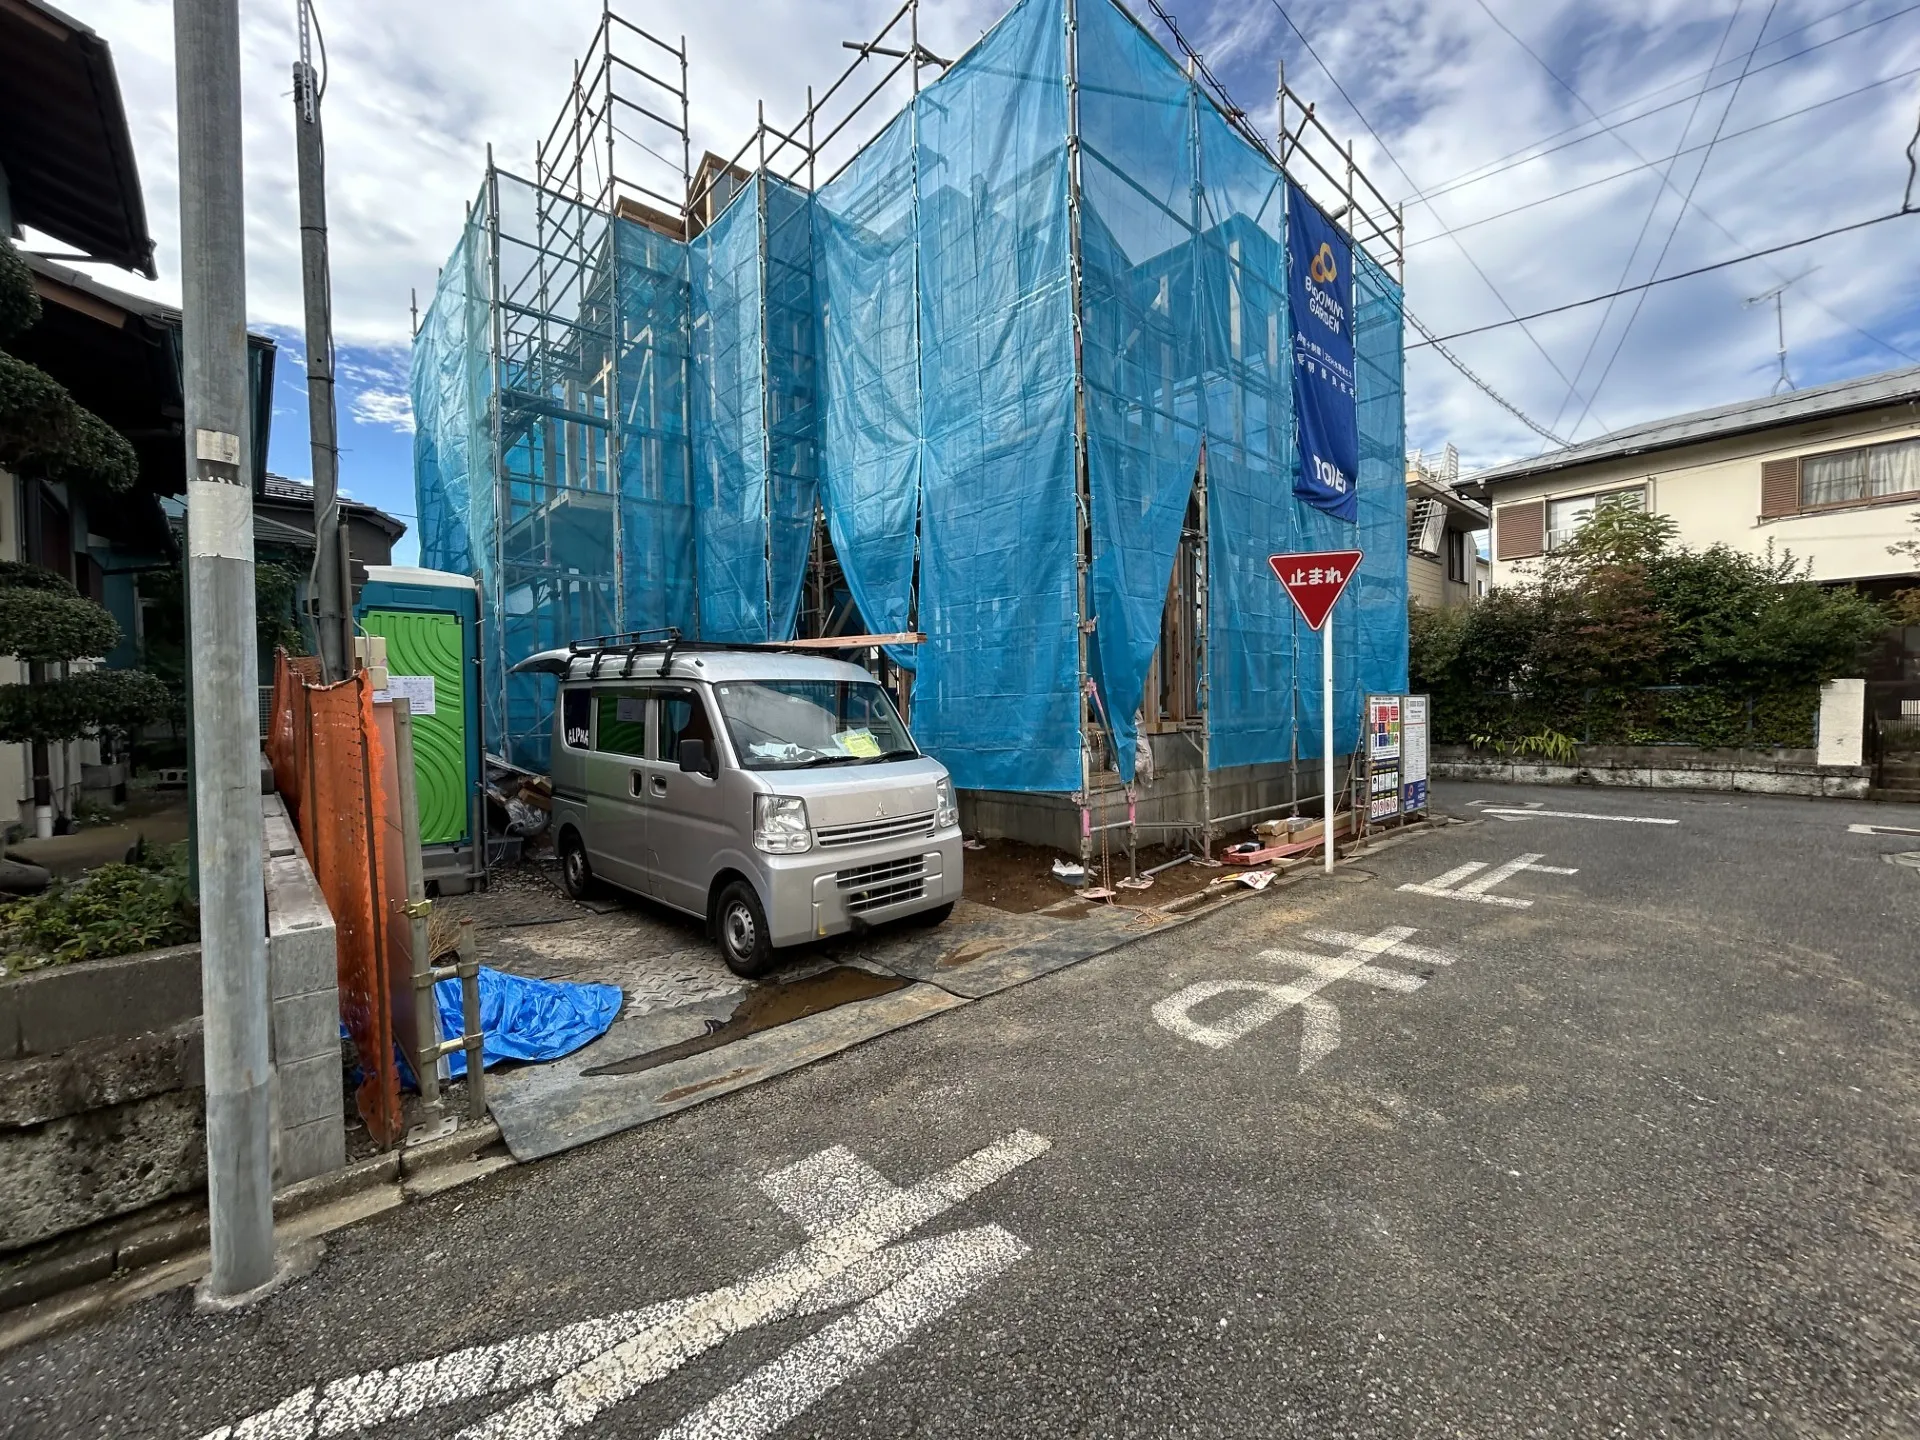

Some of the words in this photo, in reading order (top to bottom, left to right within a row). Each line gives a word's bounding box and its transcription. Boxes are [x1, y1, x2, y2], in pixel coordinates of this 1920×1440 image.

[1309, 297, 1340, 335] GARDEN
[1288, 566, 1344, 587] 止まれ
[567, 727, 589, 746] ALPHA
